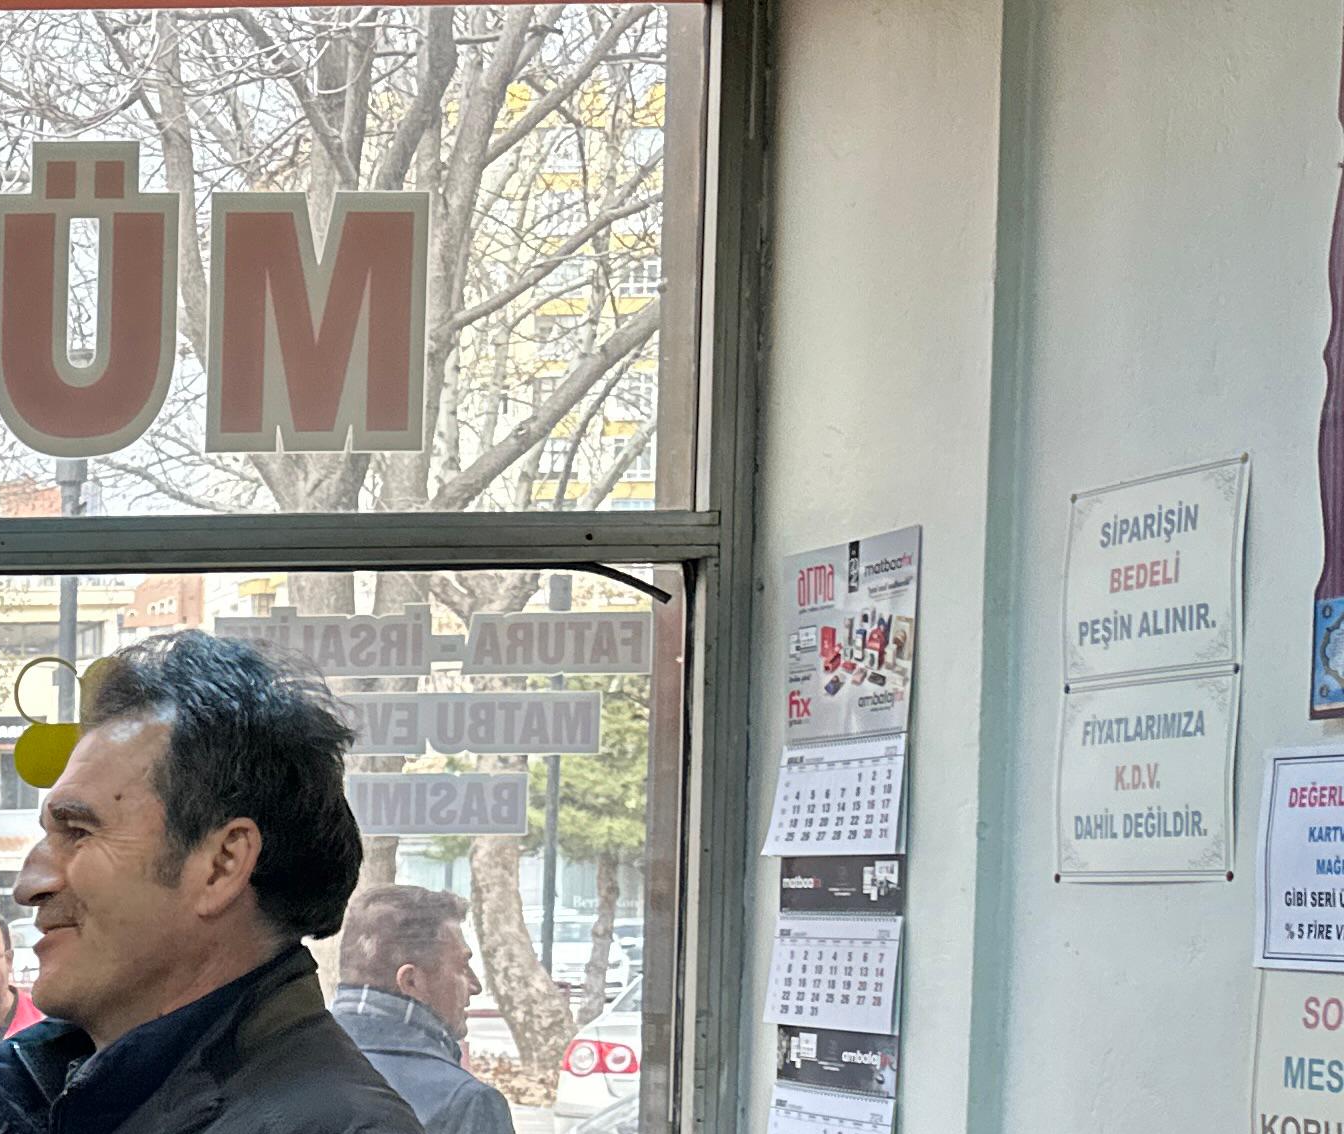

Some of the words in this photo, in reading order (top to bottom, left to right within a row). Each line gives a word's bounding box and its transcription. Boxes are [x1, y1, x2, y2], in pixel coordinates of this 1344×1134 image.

[1100, 501, 1199, 548] SİPARİŞİN
[1109, 550, 1180, 594] BEDELİ
[797, 564, 835, 607] arma
[1078, 609, 1132, 650] PEŞİN
[1138, 602, 1217, 638] ALINIR.
[788, 689, 812, 719] fix
[1081, 710, 1205, 747] FİYATLARIMIZA
[858, 772, 862, 782] 1
[872, 771, 876, 781] 2
[886, 769, 891, 779] 3
[1114, 763, 1161, 792] K.D.V.
[795, 791, 800, 800] 4
[810, 790, 815, 800] 5
[825, 789, 830, 799] 6
[840, 788, 846, 798] 7
[856, 787, 860, 796] 8
[870, 785, 875, 795] 9
[884, 784, 892, 794] 10
[1074, 807, 1118, 841] DAHİL
[1123, 803, 1208, 840] DEĞİLDİR.
[1284, 888, 1308, 907] GİBİ
[1310, 888, 1336, 908] SERİ
[1297, 923, 1305, 940] 5
[1307, 920, 1333, 940] FİRE
[790, 950, 794, 959] 1
[804, 951, 808, 960] 2
[818, 951, 823, 960] 3
[832, 952, 837, 961] 4
[848, 952, 852, 961] 5
[863, 953, 868, 962] 6
[879, 954, 884, 962] 7
[787, 964, 792, 973] 8
[802, 964, 807, 973] 9
[815, 965, 823, 974] 10
[830, 965, 837, 975] 11
[844, 966, 852, 976] 12
[860, 967, 868, 976] 13
[876, 968, 884, 977] 14
[784, 978, 792, 987] 15
[799, 978, 806, 988] 16
[813, 979, 821, 988] 17
[828, 980, 836, 989] 18
[843, 981, 851, 990] 19
[858, 982, 867, 991] 20
[874, 982, 882, 992] 21
[782, 991, 790, 1000] 22
[797, 992, 804, 1001] 23
[811, 992, 819, 1002] 24
[826, 993, 834, 1003] 25
[841, 994, 849, 1004] 26
[856, 996, 865, 1005] 27
[872, 996, 881, 1006] 28
[780, 1004, 788, 1014] 29
[795, 1005, 803, 1014] 30
[810, 1006, 818, 1016] 31
